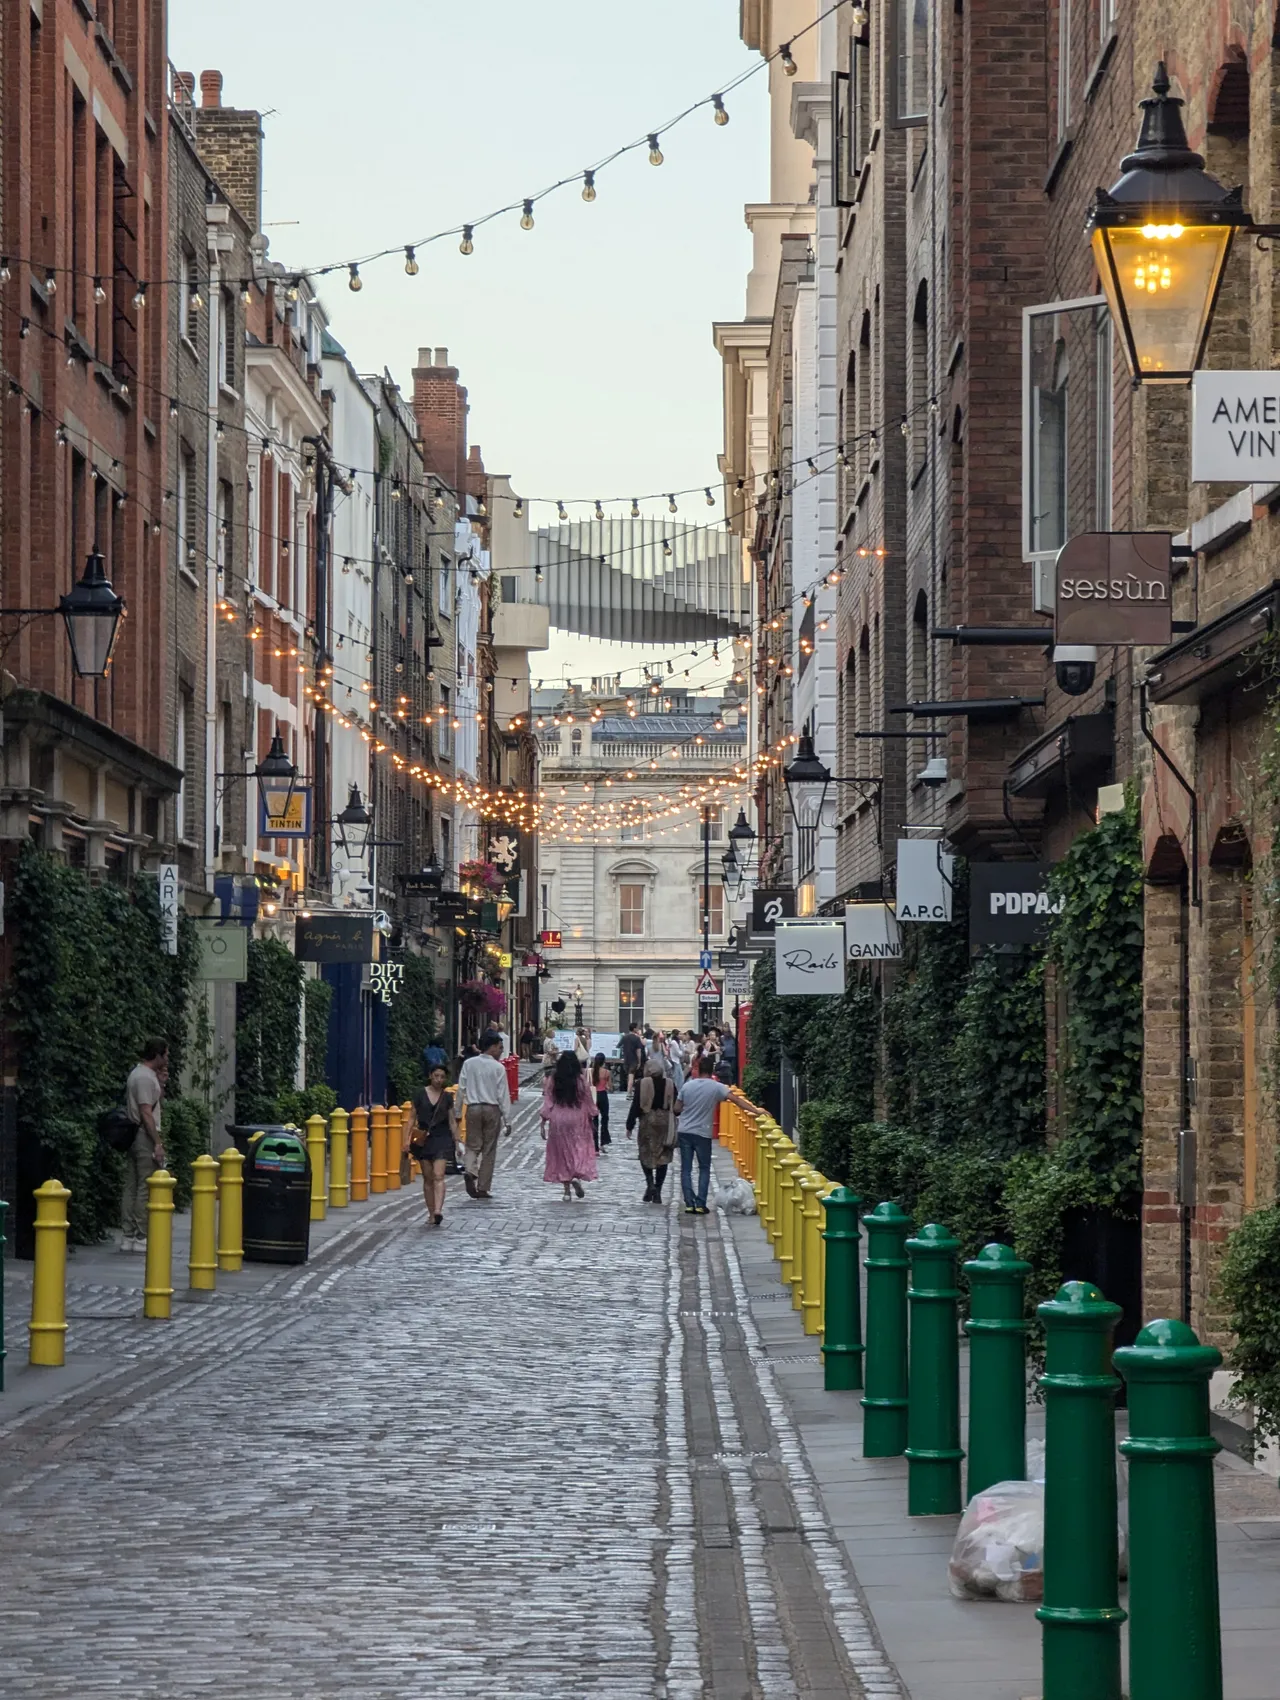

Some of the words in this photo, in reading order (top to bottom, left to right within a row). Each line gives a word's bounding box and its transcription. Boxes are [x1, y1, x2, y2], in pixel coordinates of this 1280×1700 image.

[1212, 396, 1280, 424] AME
[1227, 430, 1280, 457] VIN
[1060, 572, 1167, 600] sessùn
[269, 820, 302, 829] TINTIN
[162, 866, 176, 955] ARKET
[900, 905, 948, 919] A.P.C.
[782, 949, 839, 974] Rails
[849, 944, 900, 958] GANNI
